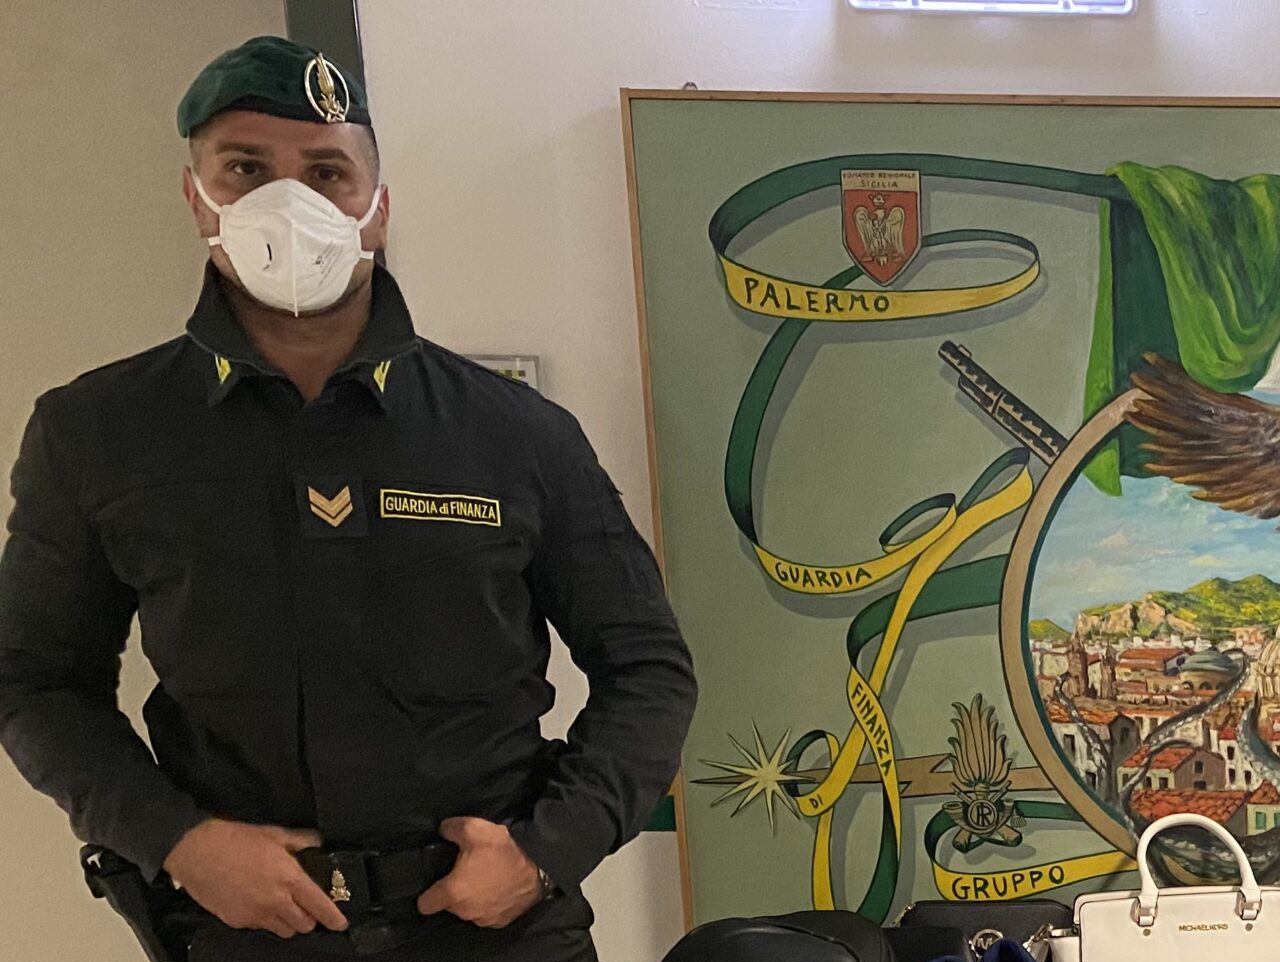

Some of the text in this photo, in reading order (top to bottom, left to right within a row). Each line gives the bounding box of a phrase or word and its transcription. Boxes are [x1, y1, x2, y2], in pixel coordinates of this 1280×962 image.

[860, 180, 899, 189] SICILIA
[744, 277, 890, 313] PALERMO
[385, 496, 496, 520] GUARDIA di FINANZA
[775, 561, 873, 589] GUARDIA
[851, 682, 893, 776] FINANZA
[809, 794, 824, 809] DI
[952, 865, 1064, 900] GRUPPO
